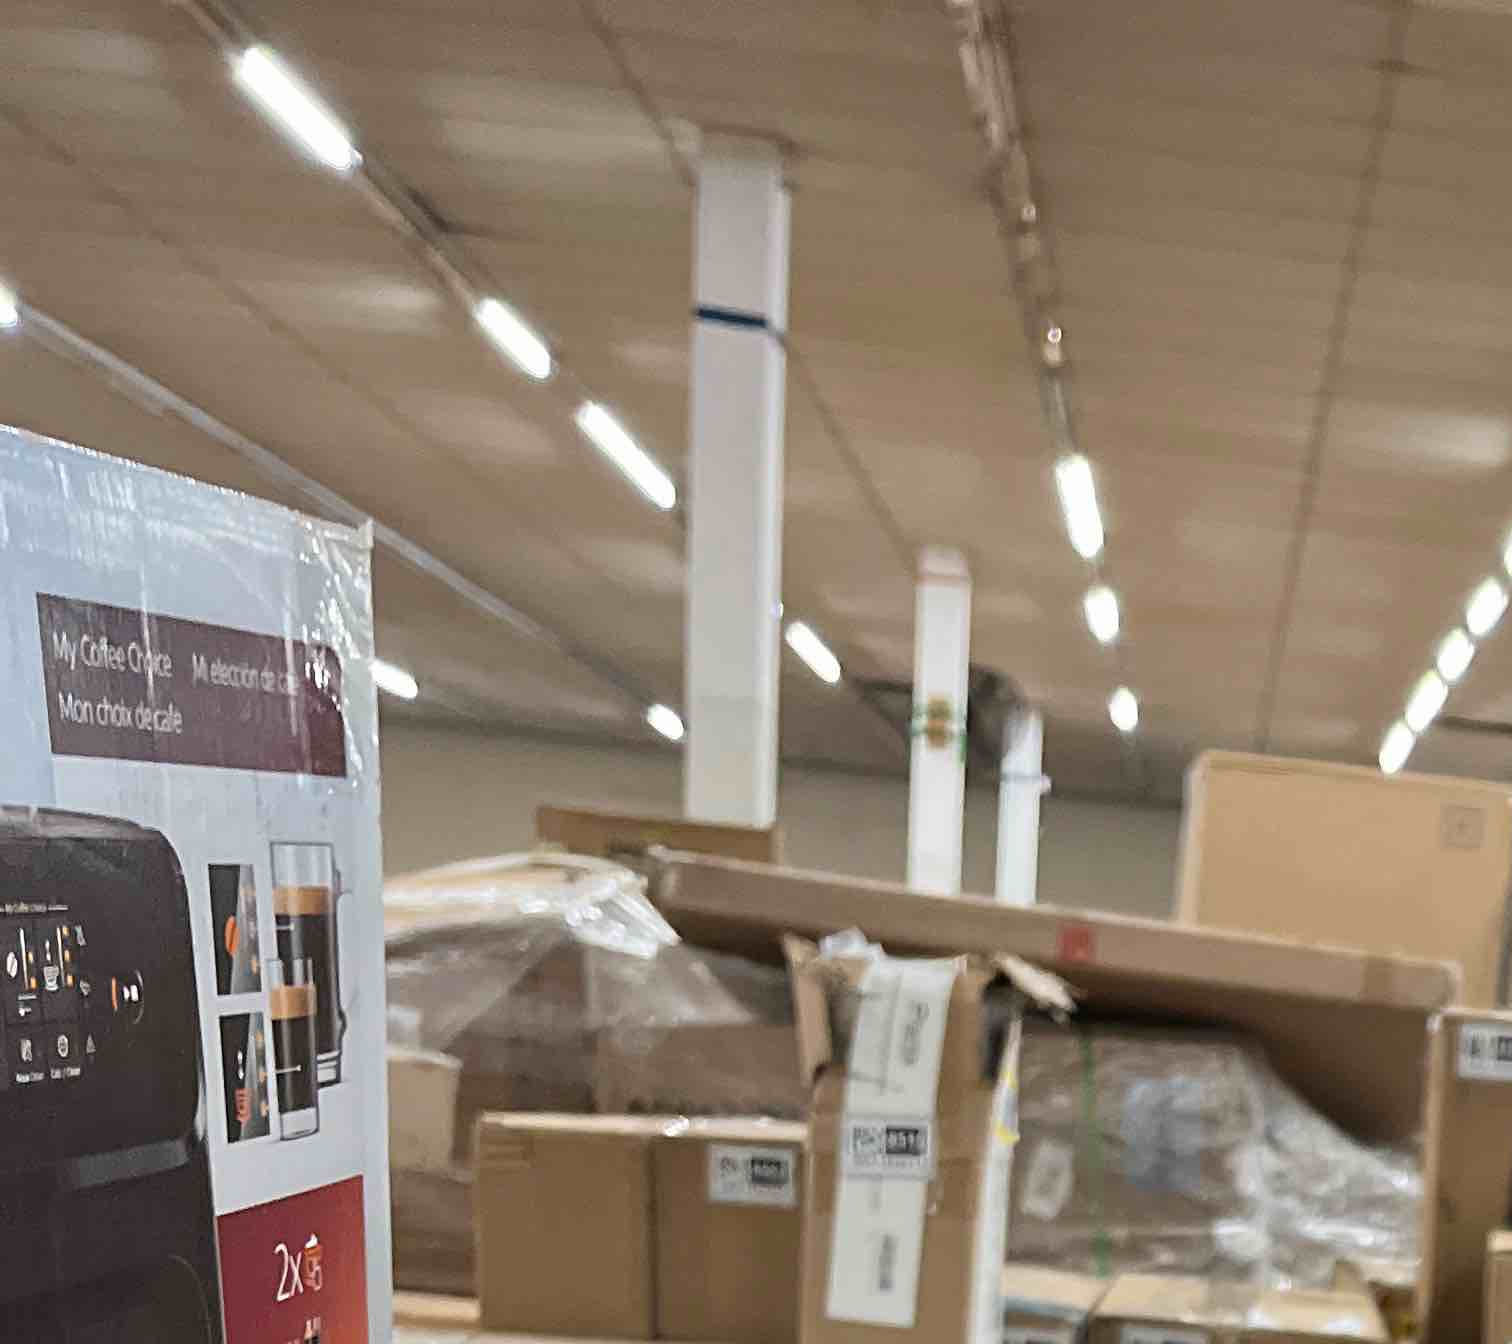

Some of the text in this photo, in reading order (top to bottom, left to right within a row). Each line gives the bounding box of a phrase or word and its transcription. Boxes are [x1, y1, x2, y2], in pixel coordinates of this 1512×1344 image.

[53, 632, 174, 679] My Coffee Choice
[58, 691, 93, 725] Mon
[96, 694, 133, 728] choix
[135, 698, 153, 732] de
